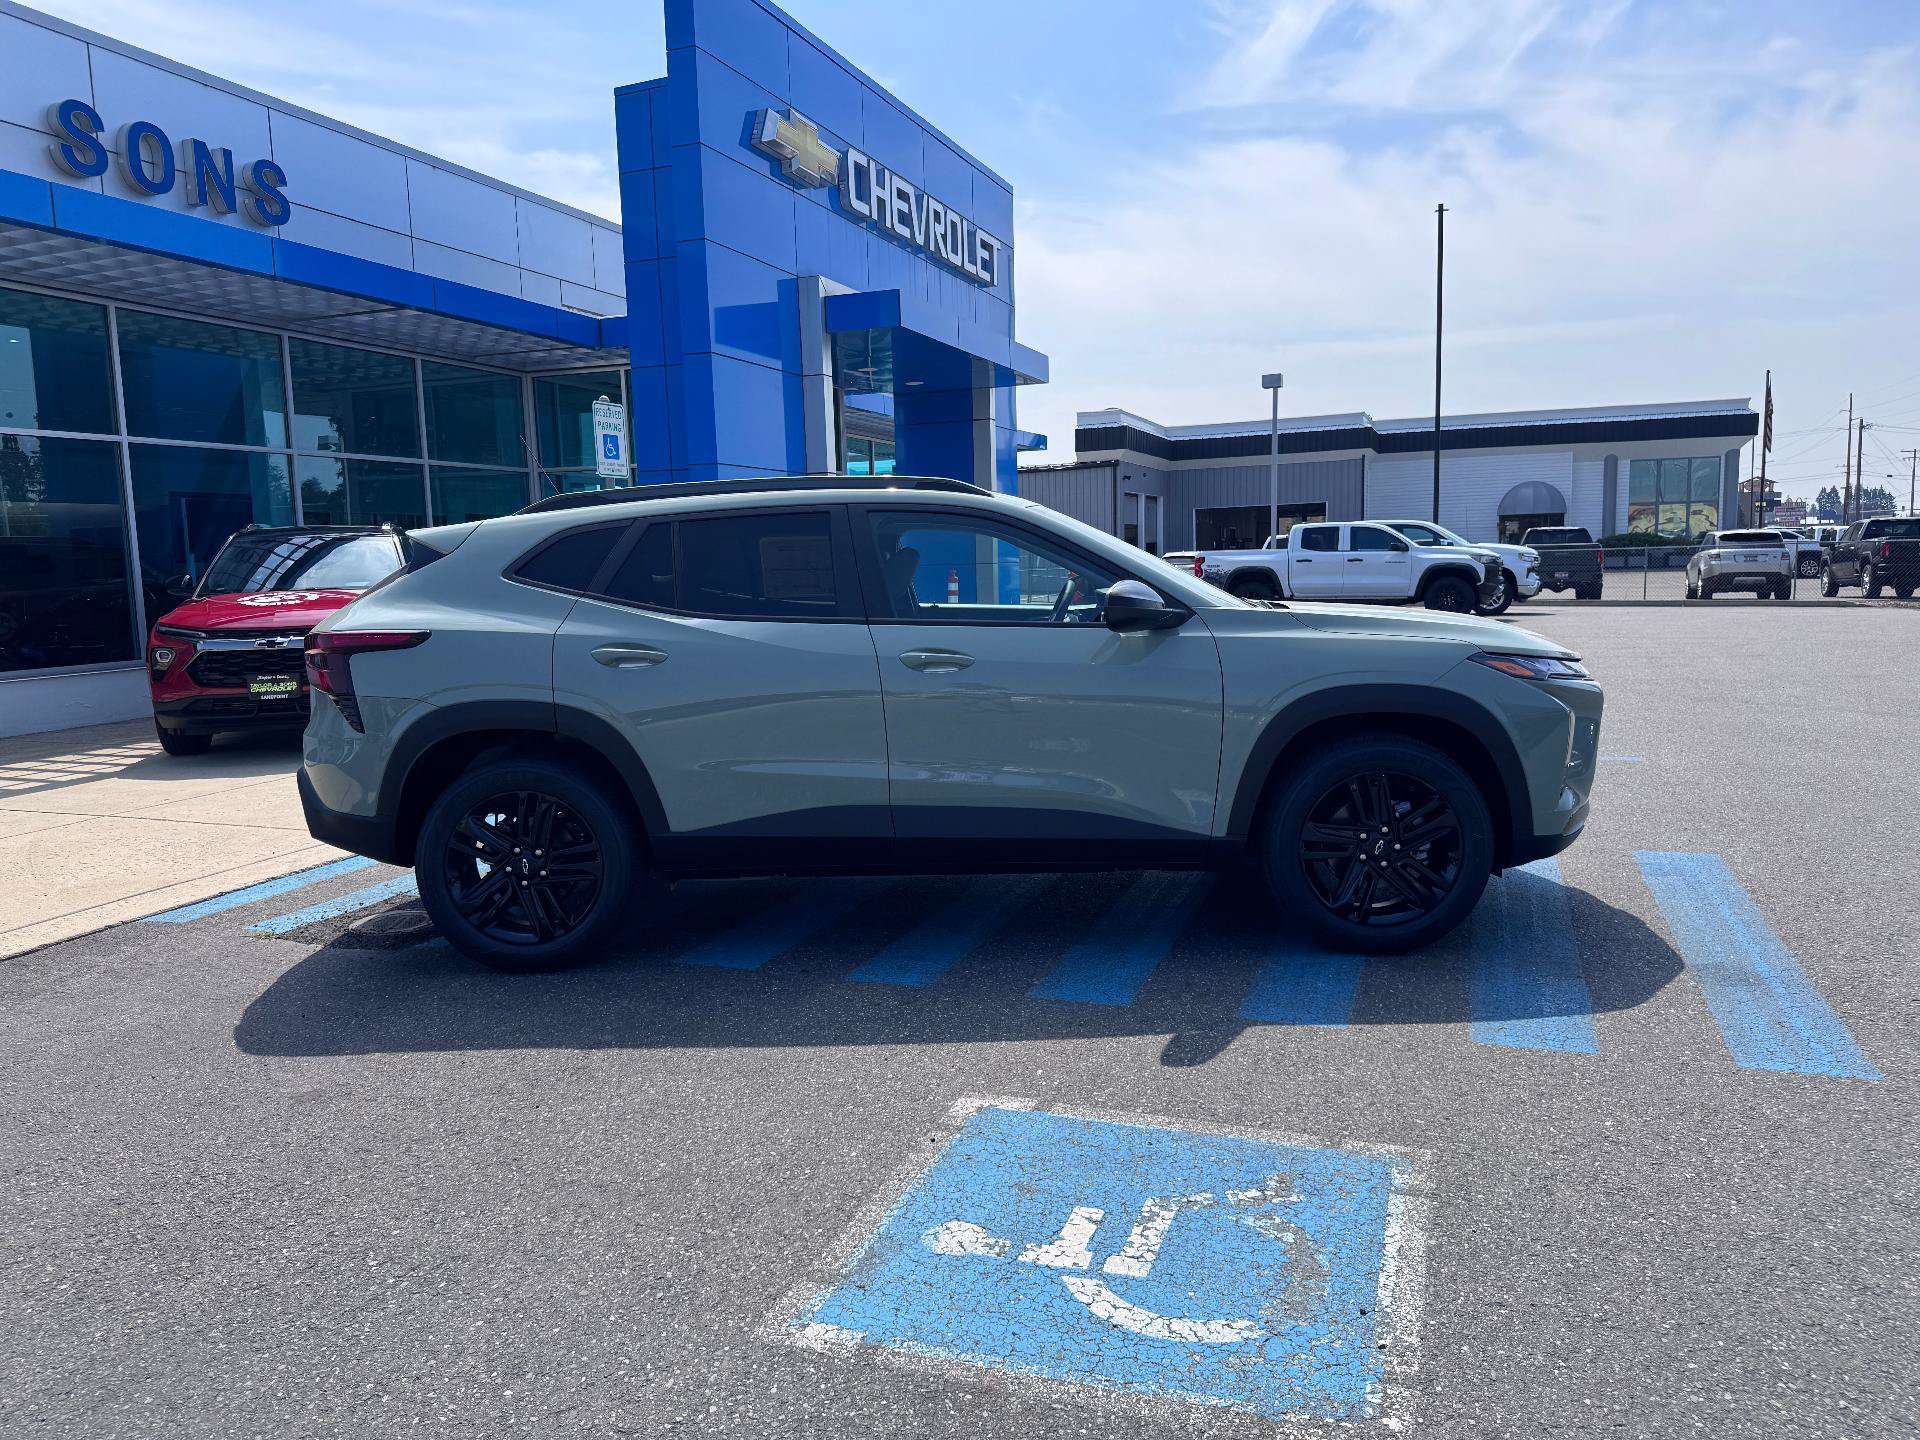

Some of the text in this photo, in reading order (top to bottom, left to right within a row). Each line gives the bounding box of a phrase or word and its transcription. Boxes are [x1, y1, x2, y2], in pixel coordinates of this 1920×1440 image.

[48, 99, 291, 226] SONS
[843, 147, 1001, 287] CHEVROLET
[595, 407, 622, 420] RESERVED
[597, 420, 622, 432] PARKING
